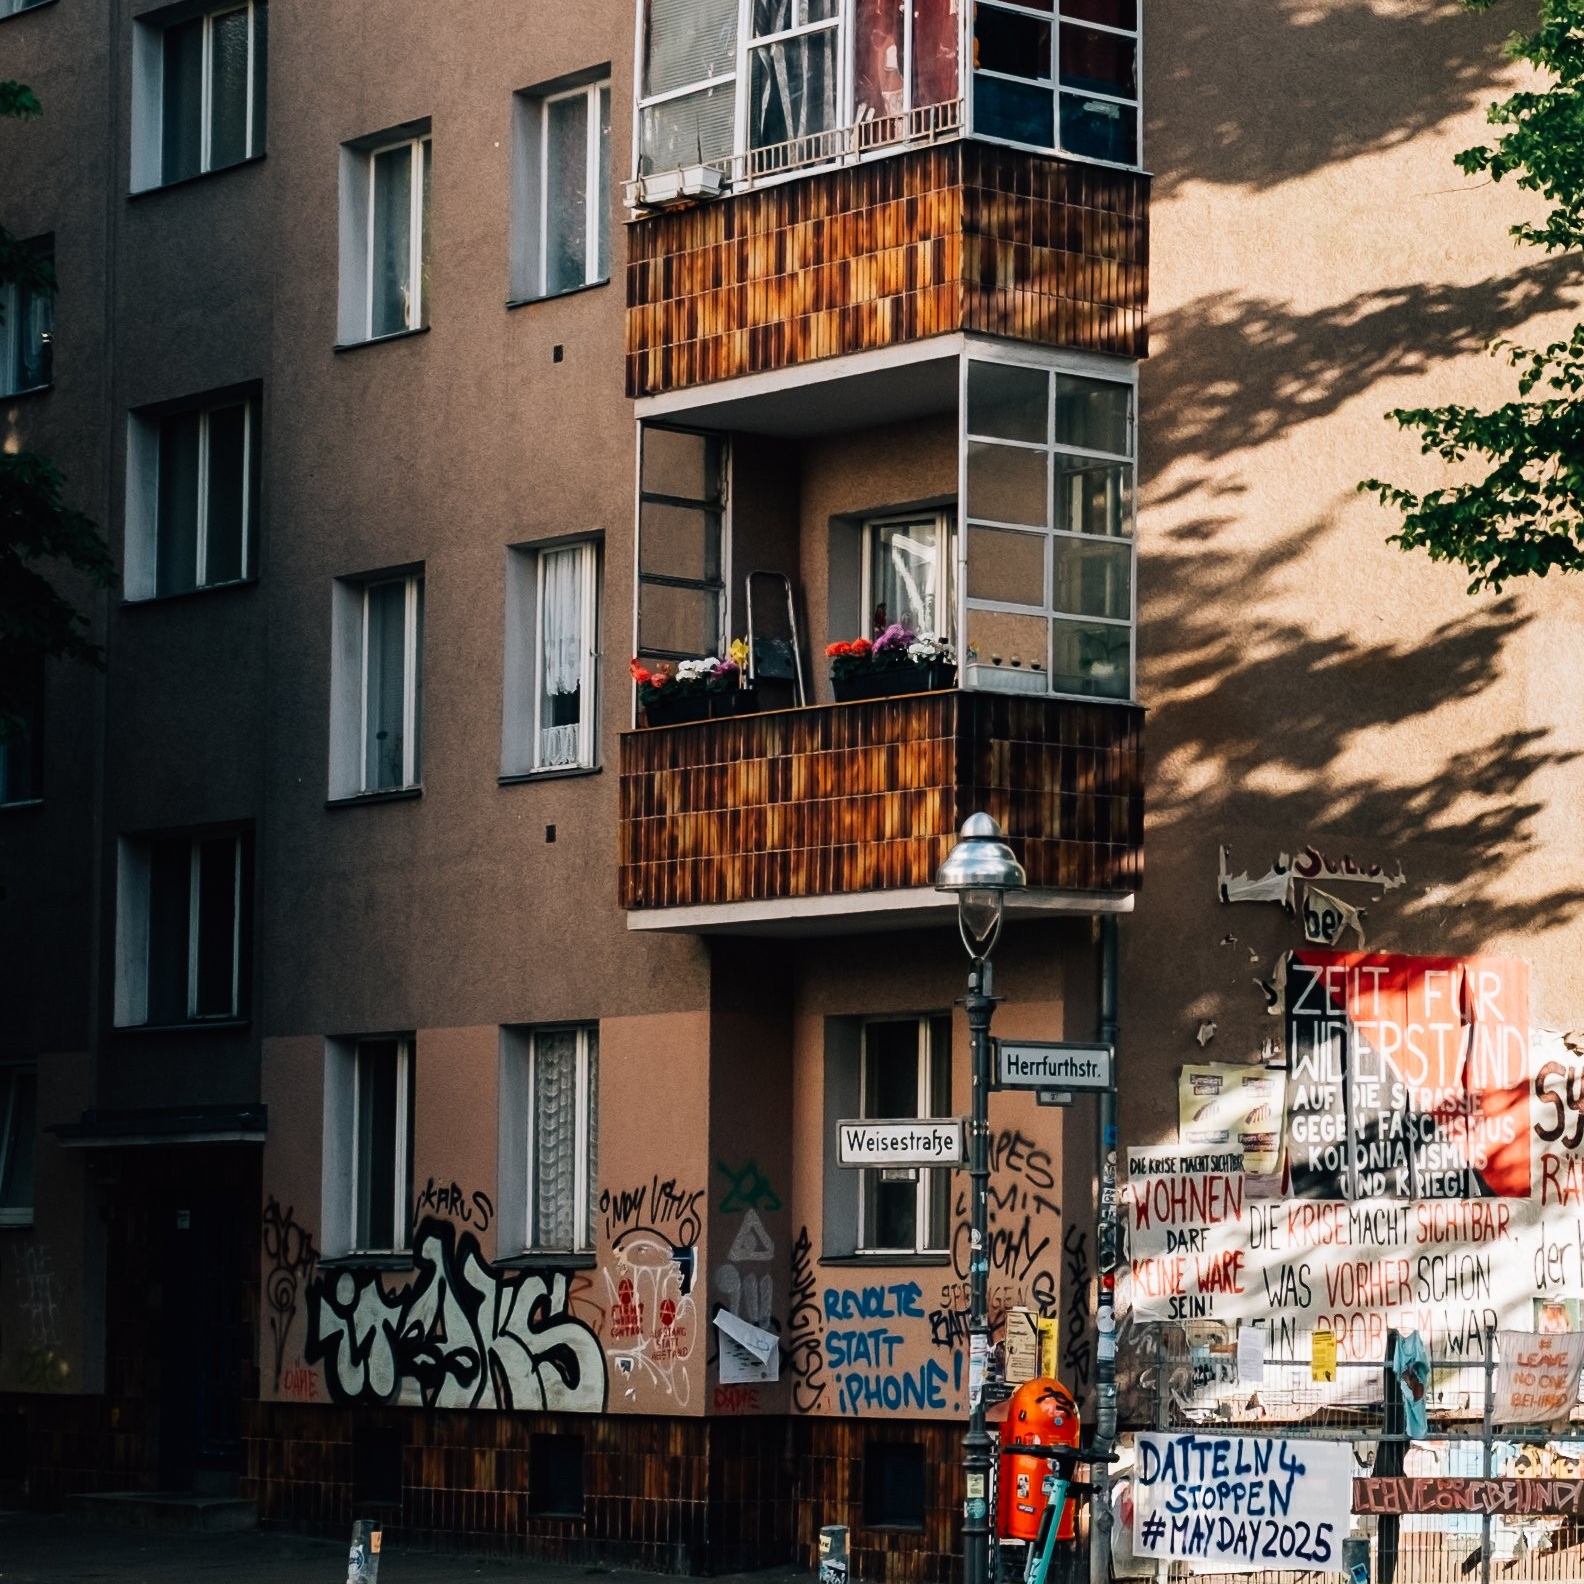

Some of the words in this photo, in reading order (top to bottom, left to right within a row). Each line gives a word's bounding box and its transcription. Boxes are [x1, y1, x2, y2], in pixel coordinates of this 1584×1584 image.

[1292, 964, 1390, 1016] ZEIT
[1007, 1053, 1101, 1078] Herrfurthstr.
[1290, 1020, 1528, 1090] WIDERSTAND
[1293, 1085, 1337, 1111] AUF
[1351, 1083, 1381, 1109] DIE
[1391, 1083, 1484, 1116] STRASSE
[846, 1128, 954, 1156] Weisestraße
[1291, 1114, 1366, 1143] GEGEN
[1377, 1111, 1517, 1145] FASCHISMUS
[1130, 1156, 1147, 1176] DIE
[1149, 1156, 1177, 1175] KRISE
[1308, 1140, 1489, 1173] KOLONIALISMUS
[1132, 1175, 1244, 1231] WOHNEN
[1340, 1172, 1387, 1200] UND
[1396, 1169, 1465, 1200] KRIEG!
[1166, 1227, 1211, 1255] DARF
[1249, 1204, 1281, 1250] DIE
[1286, 1202, 1348, 1248] KRISE
[1349, 1206, 1412, 1246] MACHT
[1132, 1257, 1187, 1298] KEINE
[1194, 1249, 1246, 1294] WARE
[1533, 1220, 1574, 1290] der
[1262, 1263, 1313, 1309] WAS
[1324, 1258, 1413, 1308] VORHER
[1417, 1254, 1492, 1304] SCHON
[823, 1280, 925, 1323] REVOLTE
[1167, 1294, 1214, 1320] SEIN!
[825, 1328, 905, 1369] STATT
[1444, 1308, 1500, 1356] WAR
[1516, 1351, 1569, 1368] LEAVE
[1513, 1372, 1537, 1387] NO
[1538, 1373, 1569, 1390] ONE
[1139, 1434, 1273, 1486] DATTELN
[1278, 1440, 1306, 1482] 4
[1165, 1478, 1294, 1518] STOPPEN
[1353, 1478, 1436, 1513] LEAVE
